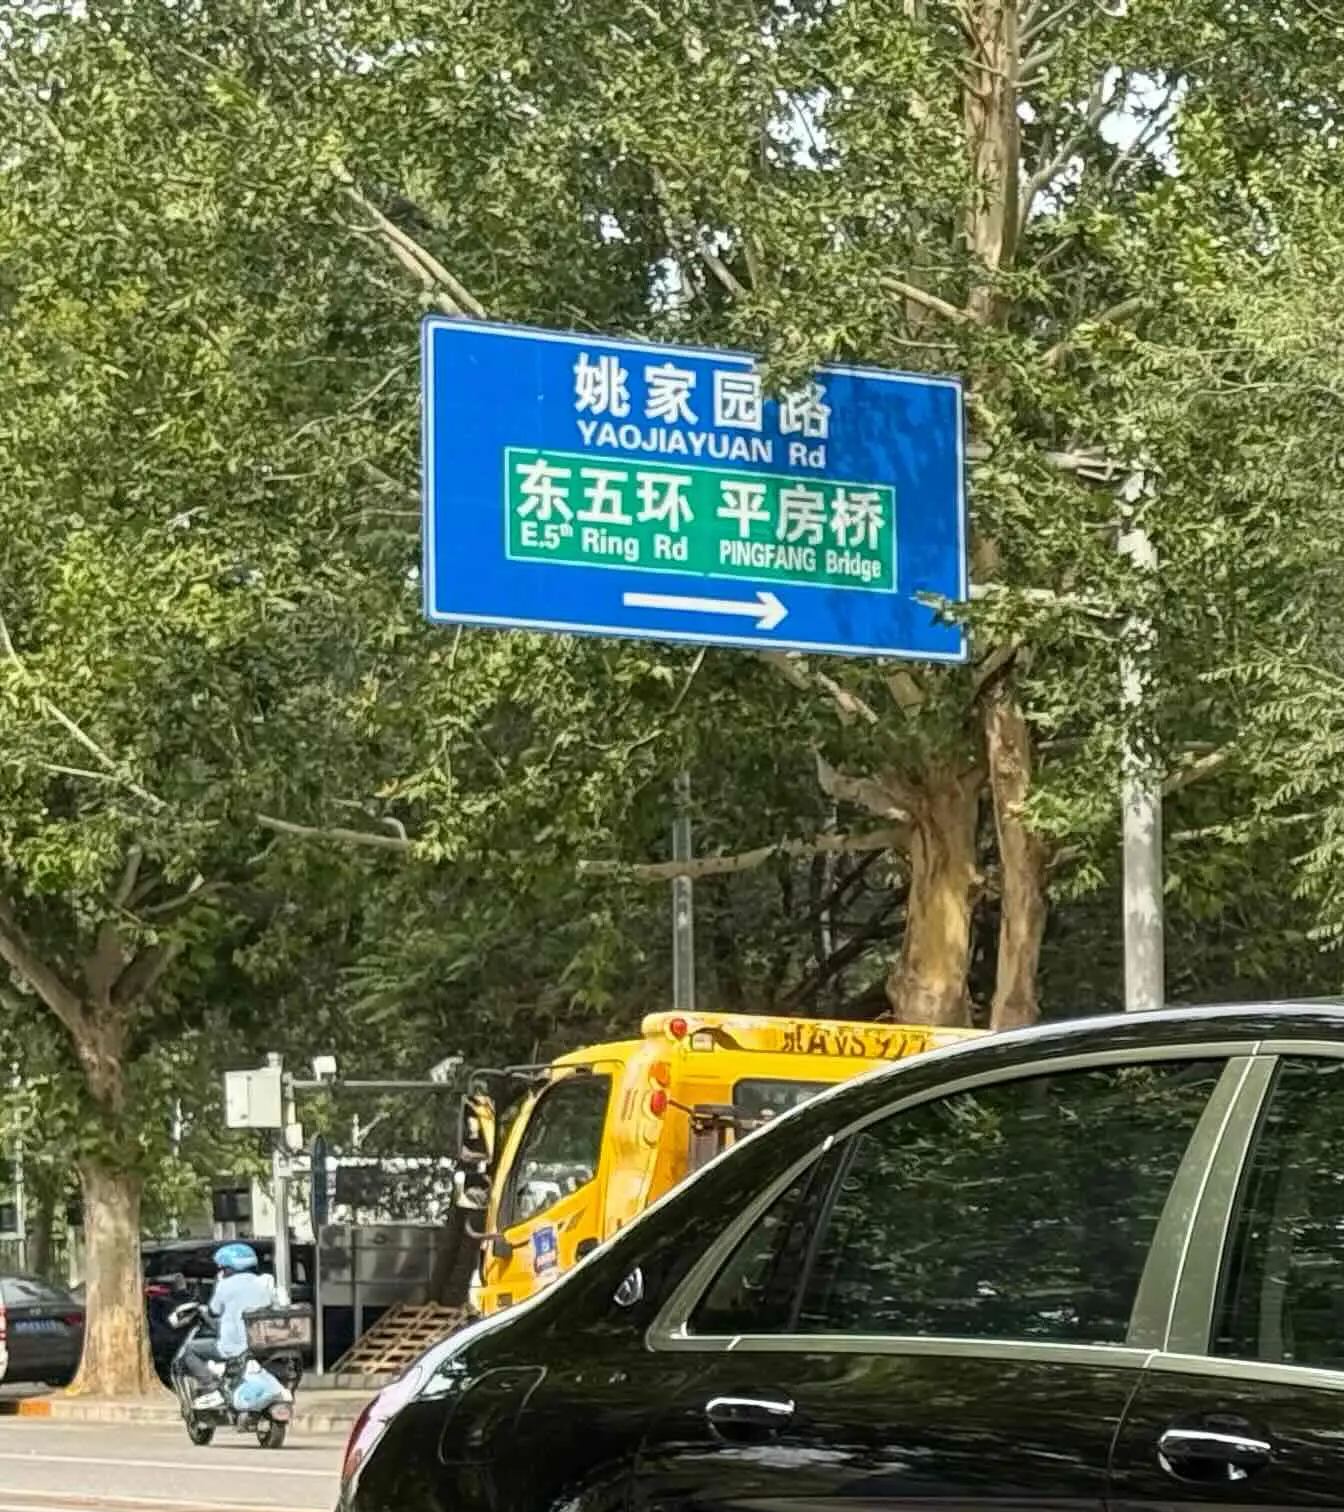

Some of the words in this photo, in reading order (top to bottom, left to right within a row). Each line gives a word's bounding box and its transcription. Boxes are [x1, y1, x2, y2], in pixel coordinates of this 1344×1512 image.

[573, 351, 832, 440] 姚家园路
[576, 418, 774, 465] YAOJIAYUAN
[788, 441, 827, 470] Rd
[515, 458, 695, 533] 东五环
[716, 479, 886, 550] 平房桥
[581, 526, 640, 562] Ring
[653, 532, 689, 561] Rd
[719, 538, 817, 573] PINGFANG
[825, 549, 882, 583] Bridge
